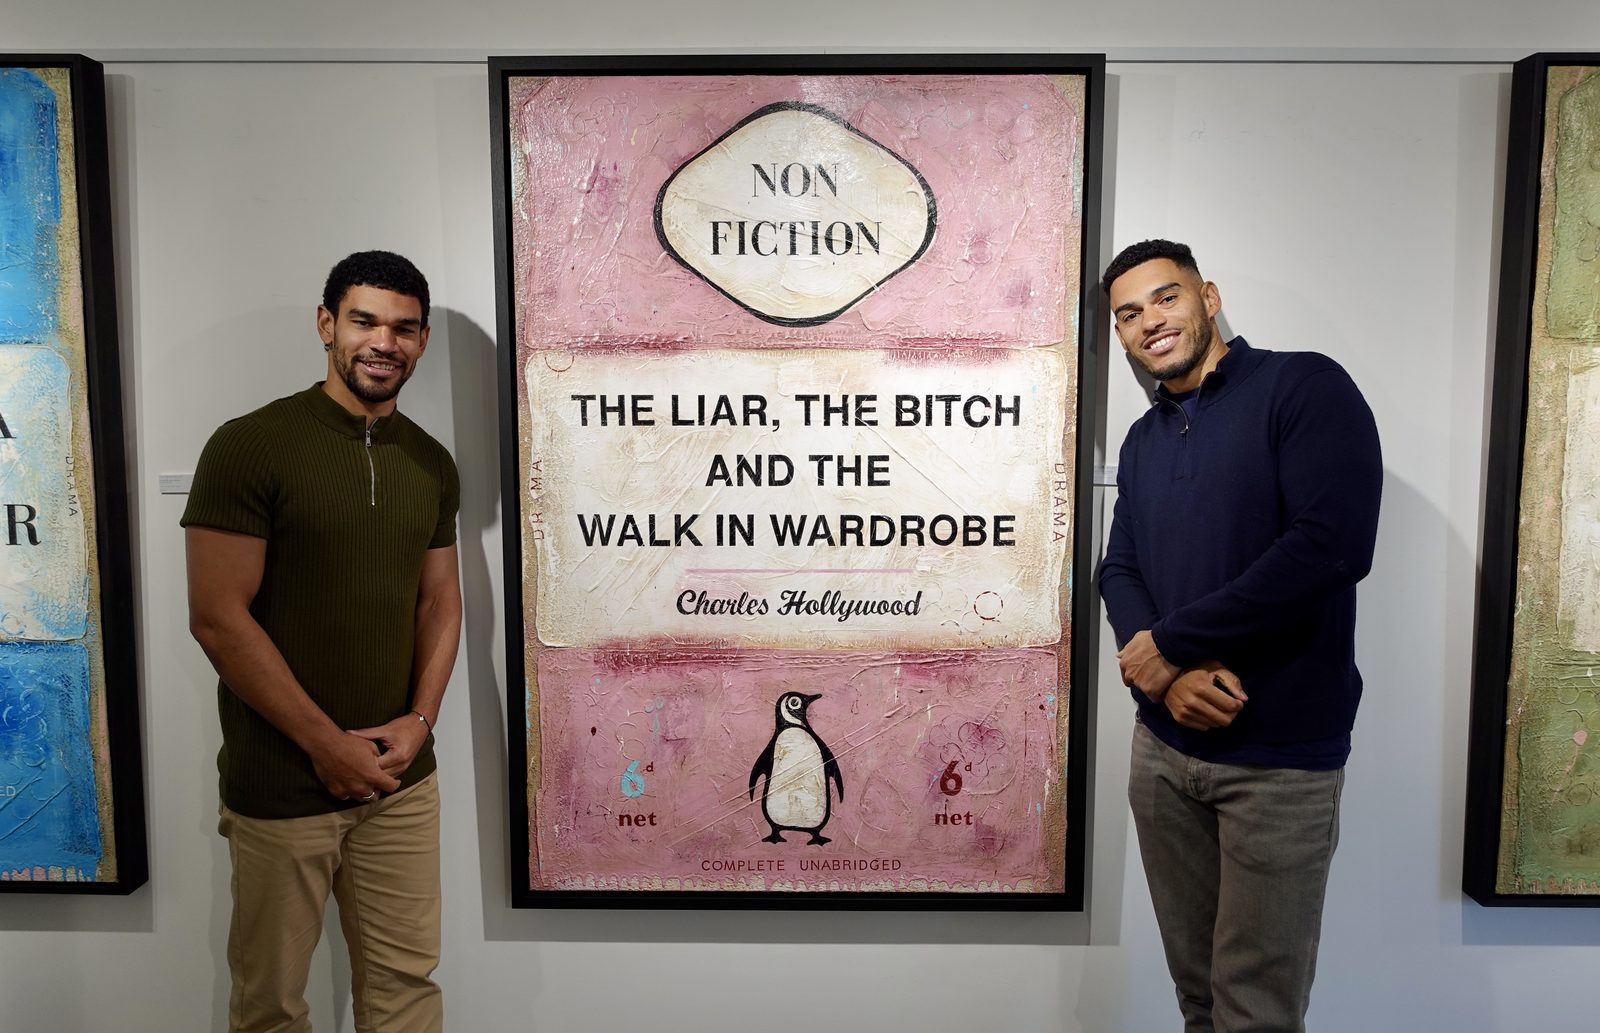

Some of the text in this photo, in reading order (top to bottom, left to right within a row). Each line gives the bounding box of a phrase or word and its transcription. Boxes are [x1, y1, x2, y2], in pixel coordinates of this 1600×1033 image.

[751, 162, 840, 198] NON
[709, 220, 883, 256] FICTION
[571, 394, 1021, 433] THE LIAR, THE BITCH
[705, 454, 891, 487] AND THE
[1052, 463, 1068, 542] DRAMA
[577, 513, 1016, 547] WALK IN WARDROBE
[676, 589, 923, 623] Charles Hollywood
[618, 812, 657, 827] net
[934, 810, 973, 826] net
[701, 858, 902, 872] COMPLETE UNABRIDGED
